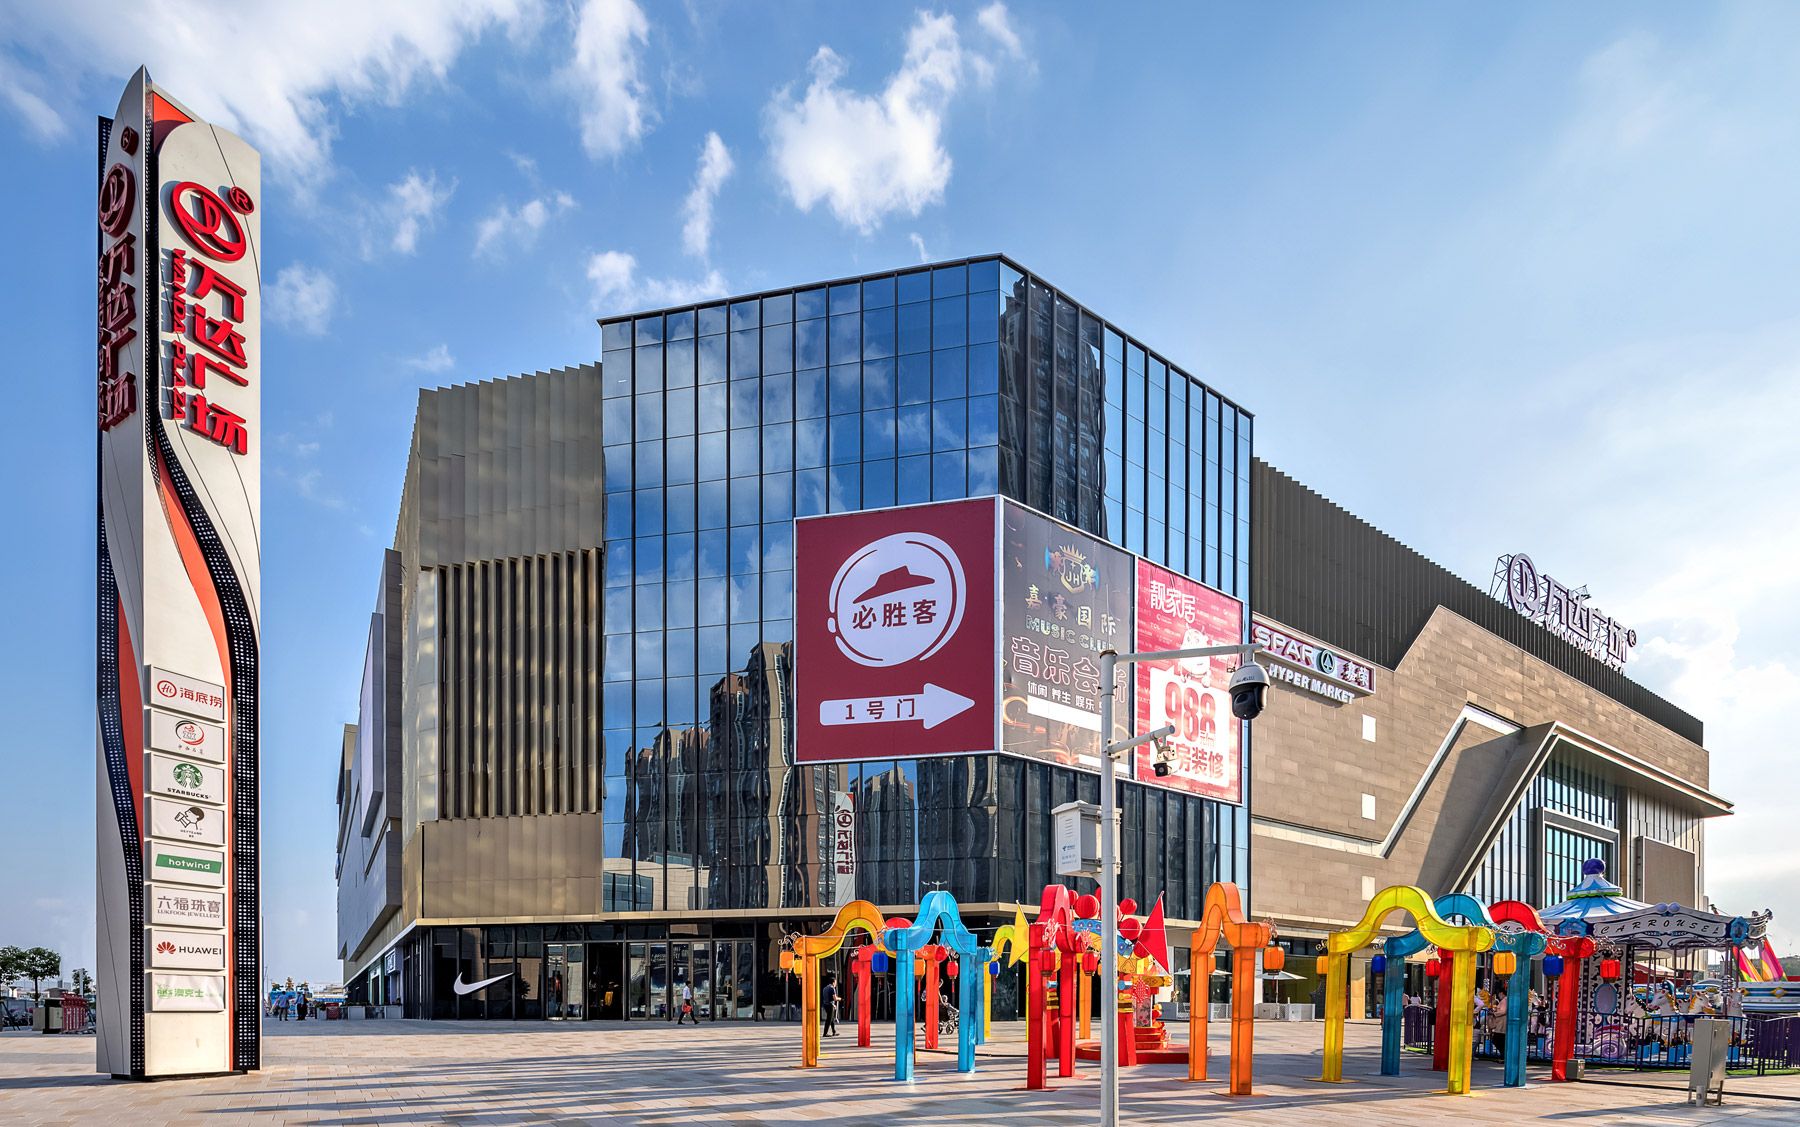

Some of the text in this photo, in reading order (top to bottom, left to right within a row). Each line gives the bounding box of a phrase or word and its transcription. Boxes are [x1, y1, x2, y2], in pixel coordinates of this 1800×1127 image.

[173, 248, 186, 420] WANDA PLAZA
[191, 257, 249, 456] 万达广场
[852, 599, 937, 630] 必胜客
[1025, 584, 1116, 635] 嘉豪国际
[1150, 580, 1196, 624] 靓家居
[1025, 614, 1076, 644] MUSIC
[1543, 574, 1627, 663] 万达广场
[1254, 626, 1314, 662] SPAR
[180, 687, 223, 709] 海底捞
[1027, 680, 1096, 711] 休闲 养生 娱乐
[1268, 663, 1355, 705] HYPER MARKET
[845, 698, 915, 720] 1号门
[1165, 681, 1216, 742] 988
[167, 788, 209, 799] STARBUCKS
[168, 858, 211, 870] hotwind
[157, 896, 221, 914] 六福珠寶
[157, 909, 221, 919] LUKFOOK JEWELLERY
[1600, 918, 1720, 935] CARROUSEL
[178, 946, 222, 955] HUAWEI
